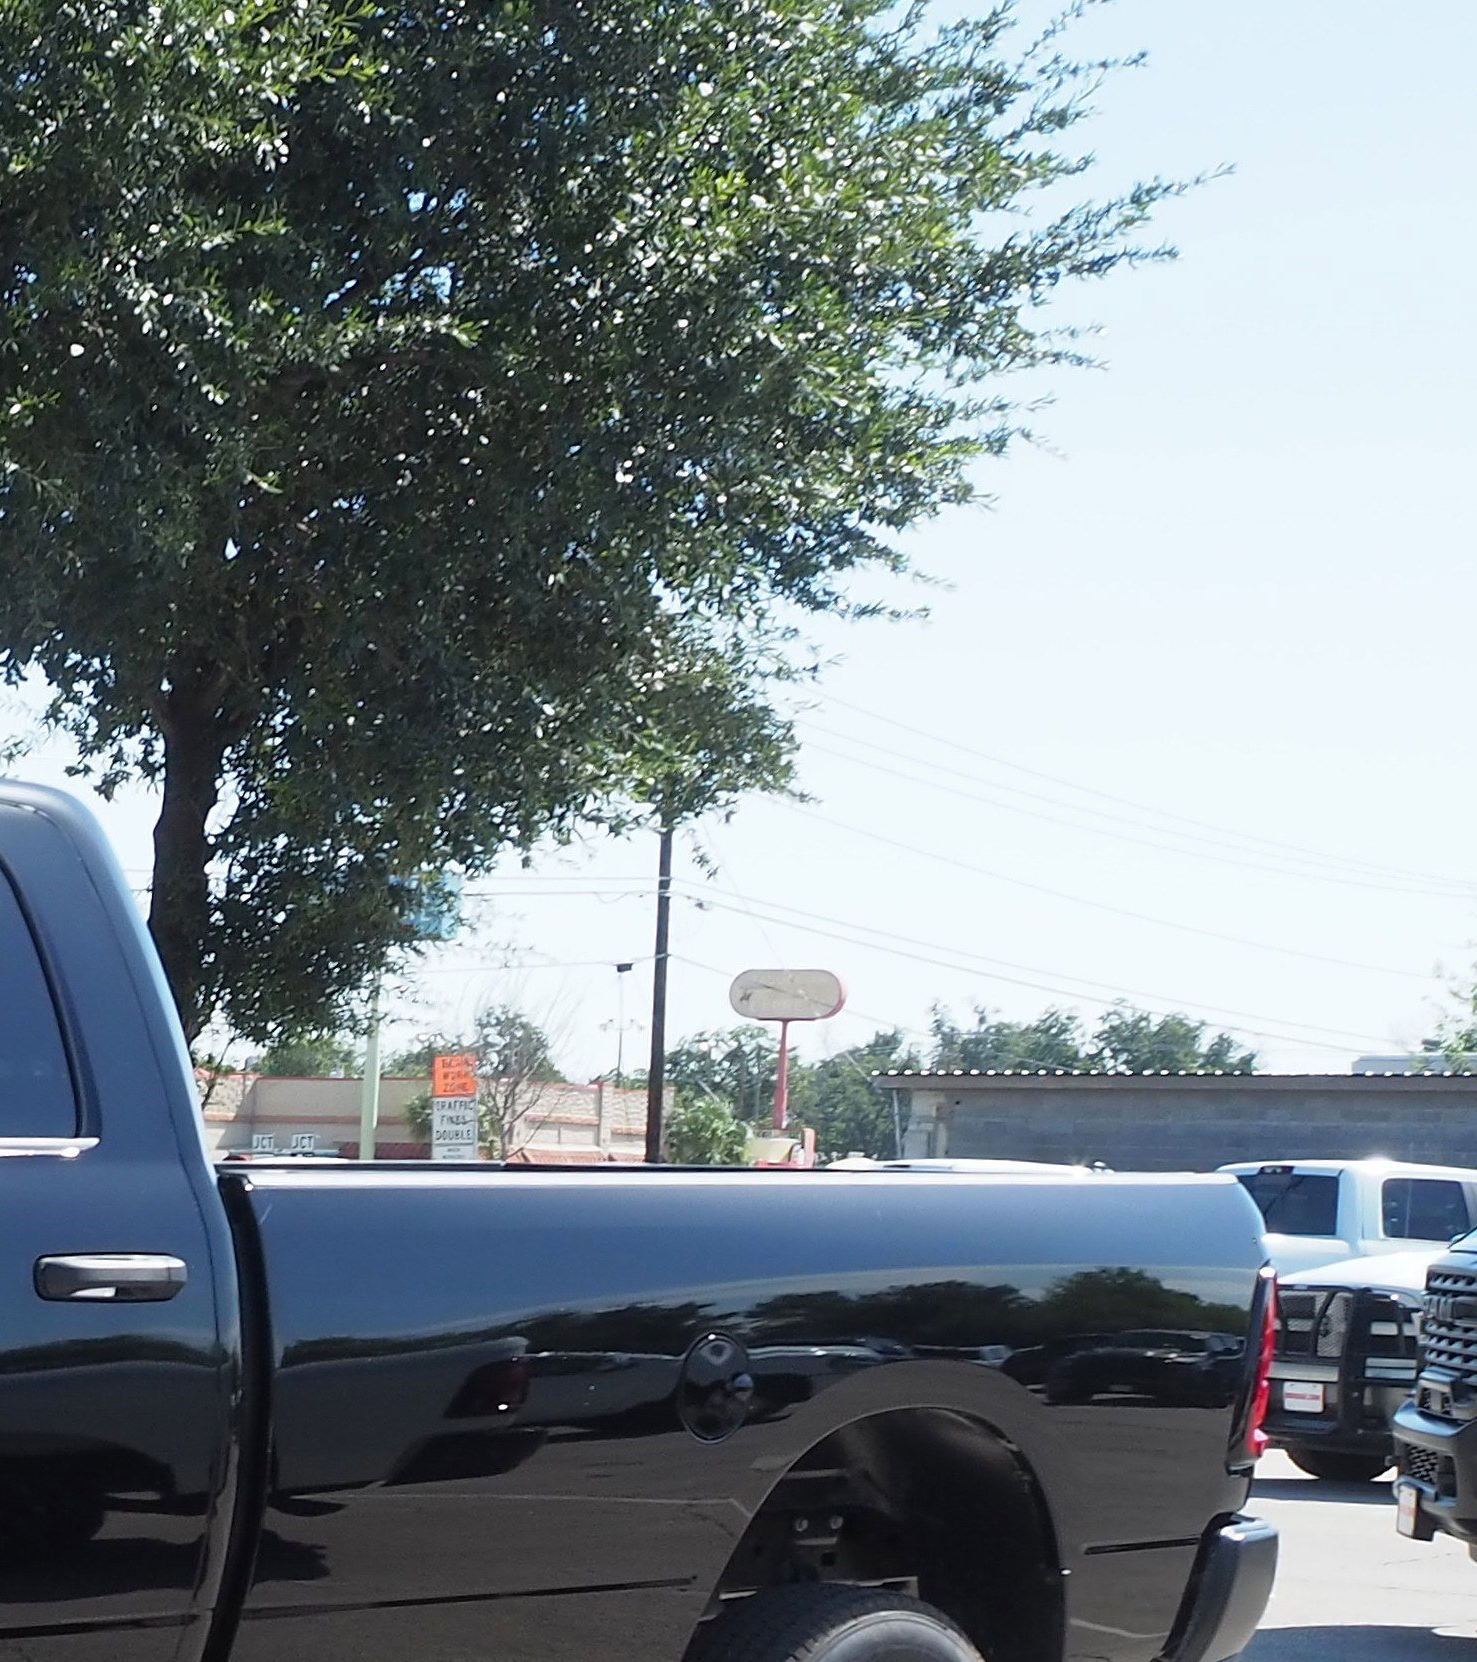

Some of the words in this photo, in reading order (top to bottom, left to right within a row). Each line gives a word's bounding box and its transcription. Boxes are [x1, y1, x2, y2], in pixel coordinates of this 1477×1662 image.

[436, 1100, 473, 1111] TRAFFIC
[435, 1129, 472, 1141] DOUBLE
[254, 1136, 274, 1149] JCT
[292, 1136, 313, 1149] JCT
